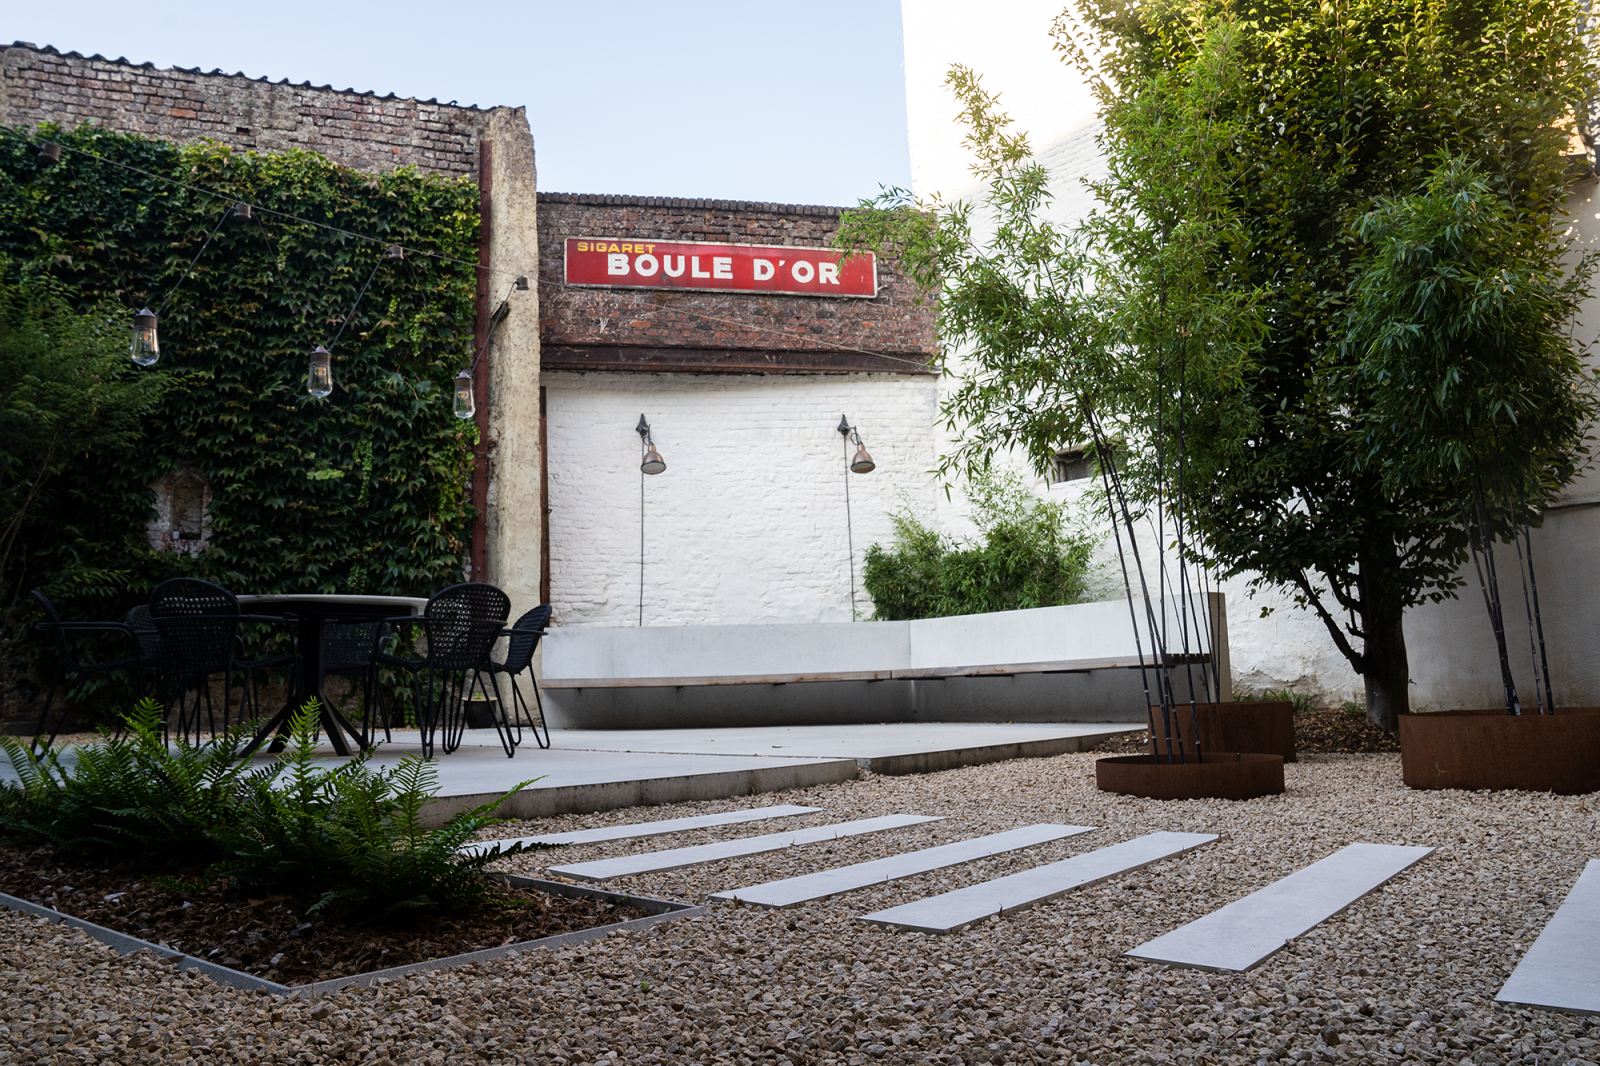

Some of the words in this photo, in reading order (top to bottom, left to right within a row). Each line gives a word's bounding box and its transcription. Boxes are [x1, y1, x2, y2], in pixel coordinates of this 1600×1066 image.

[577, 241, 656, 254] SIGARET
[607, 253, 734, 280] BOULE
[753, 258, 841, 285] D'OR
